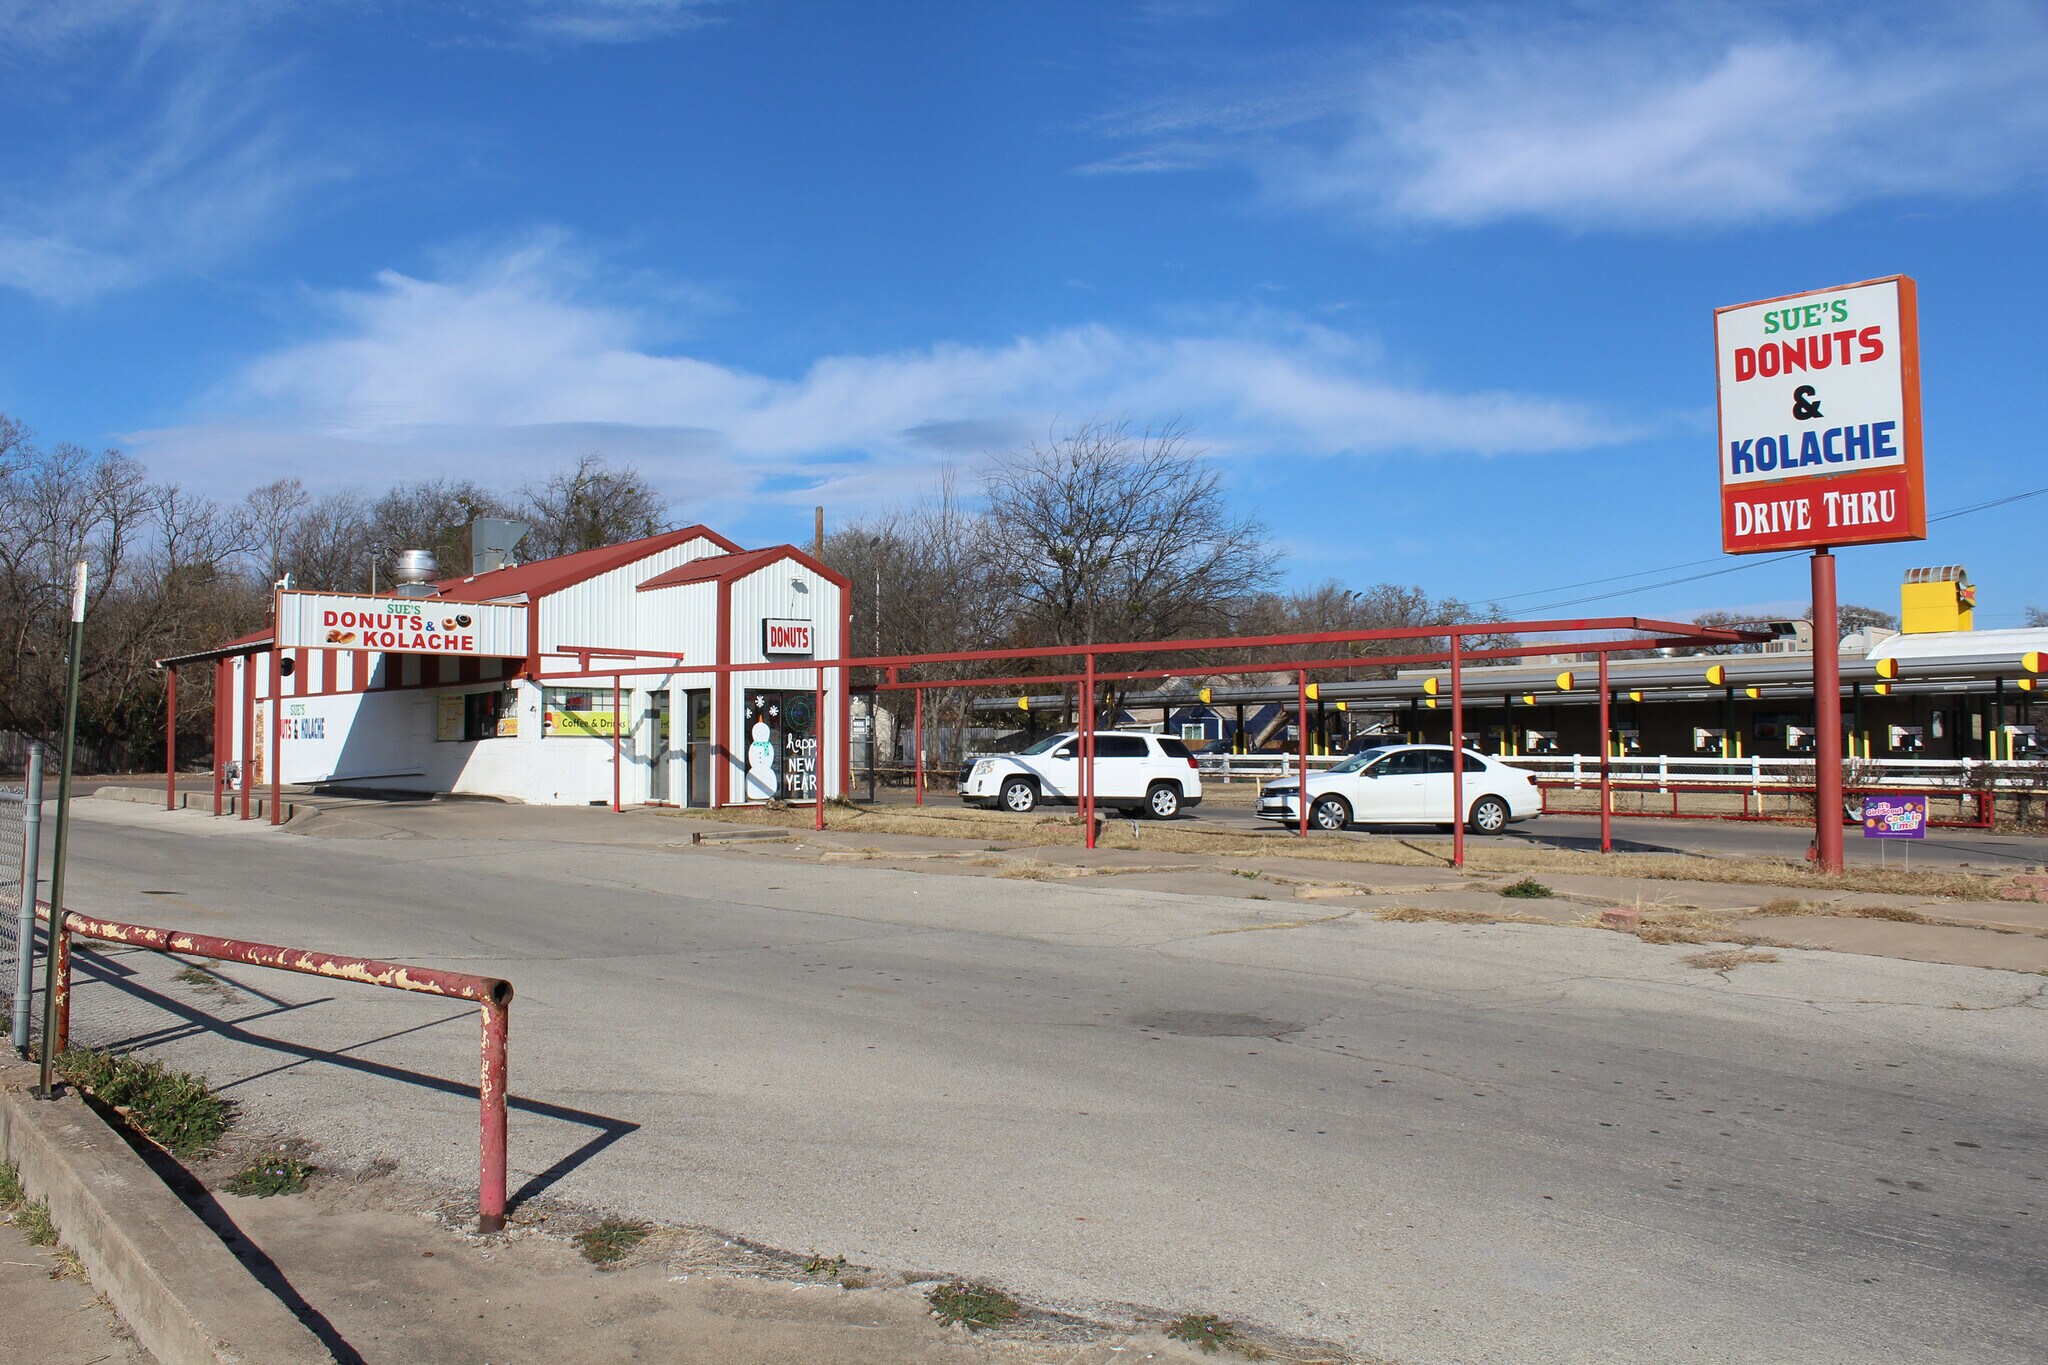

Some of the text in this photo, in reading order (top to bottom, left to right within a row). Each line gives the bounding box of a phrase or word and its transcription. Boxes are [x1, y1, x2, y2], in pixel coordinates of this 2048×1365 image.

[1764, 299, 1848, 334] SUE'S
[1734, 325, 1884, 382] DONUTS
[1792, 385, 1824, 420] &
[1730, 421, 1897, 475] KOLACHE
[1734, 489, 1896, 536] DRIVE THRU
[387, 604, 421, 614] SUE'S
[324, 611, 435, 632] DONUTS &
[363, 631, 473, 650] KOLACHE
[771, 626, 809, 648] DONUTS
[562, 718, 626, 728] Coffee & Driks
[788, 757, 816, 772] NEW
[785, 774, 817, 791] YEAR
[1866, 807, 1903, 816] Girl Scout
[1885, 811, 1921, 824] Cookie
[1890, 820, 1918, 831] Time!
